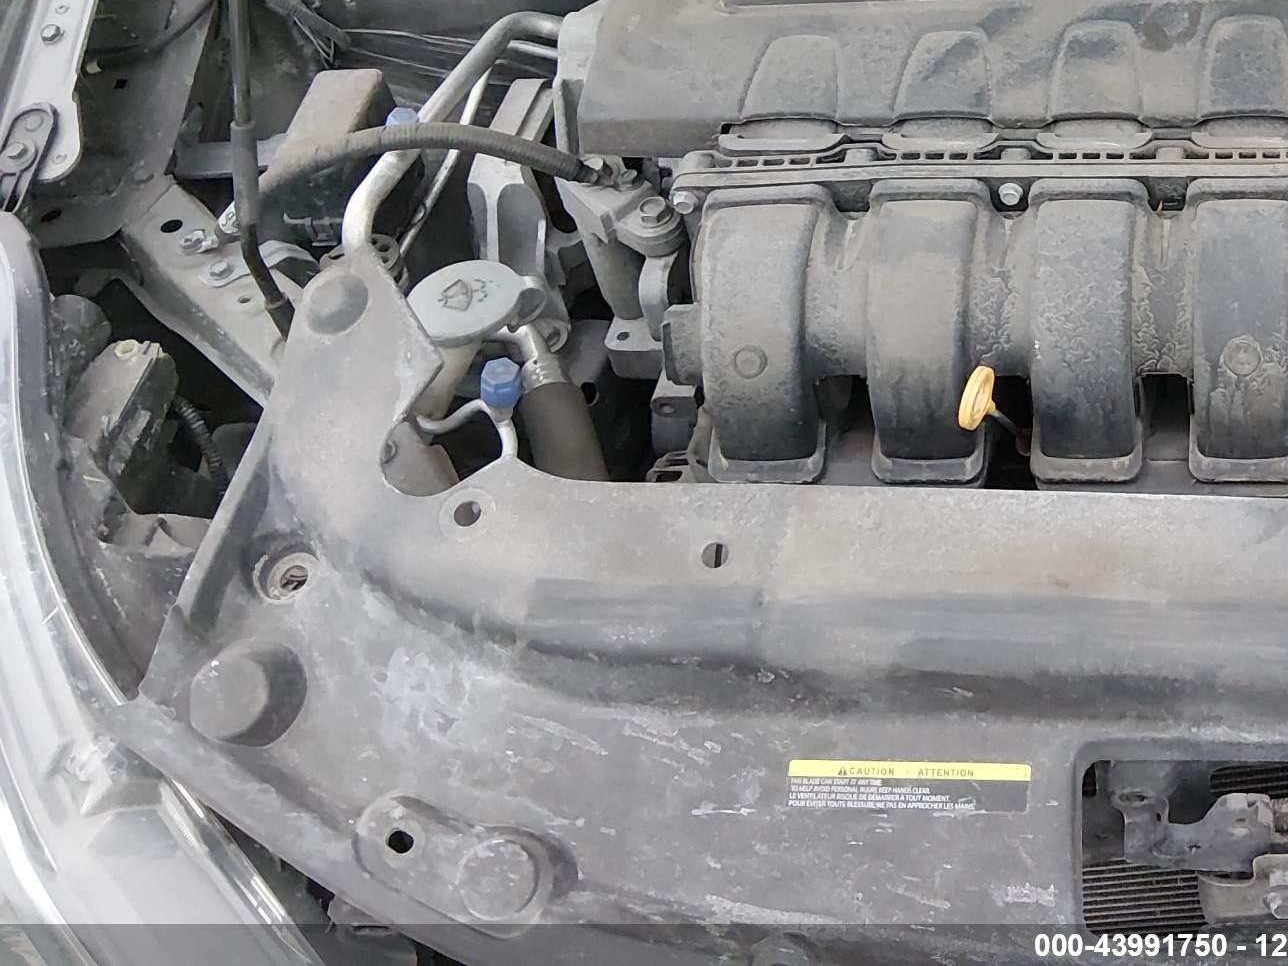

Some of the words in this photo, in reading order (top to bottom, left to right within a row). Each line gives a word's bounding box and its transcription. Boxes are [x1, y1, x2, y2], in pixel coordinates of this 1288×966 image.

[849, 767, 895, 777] CAUTION
[917, 768, 974, 777] ATTENTION
[907, 802, 943, 810] APPROCHER
